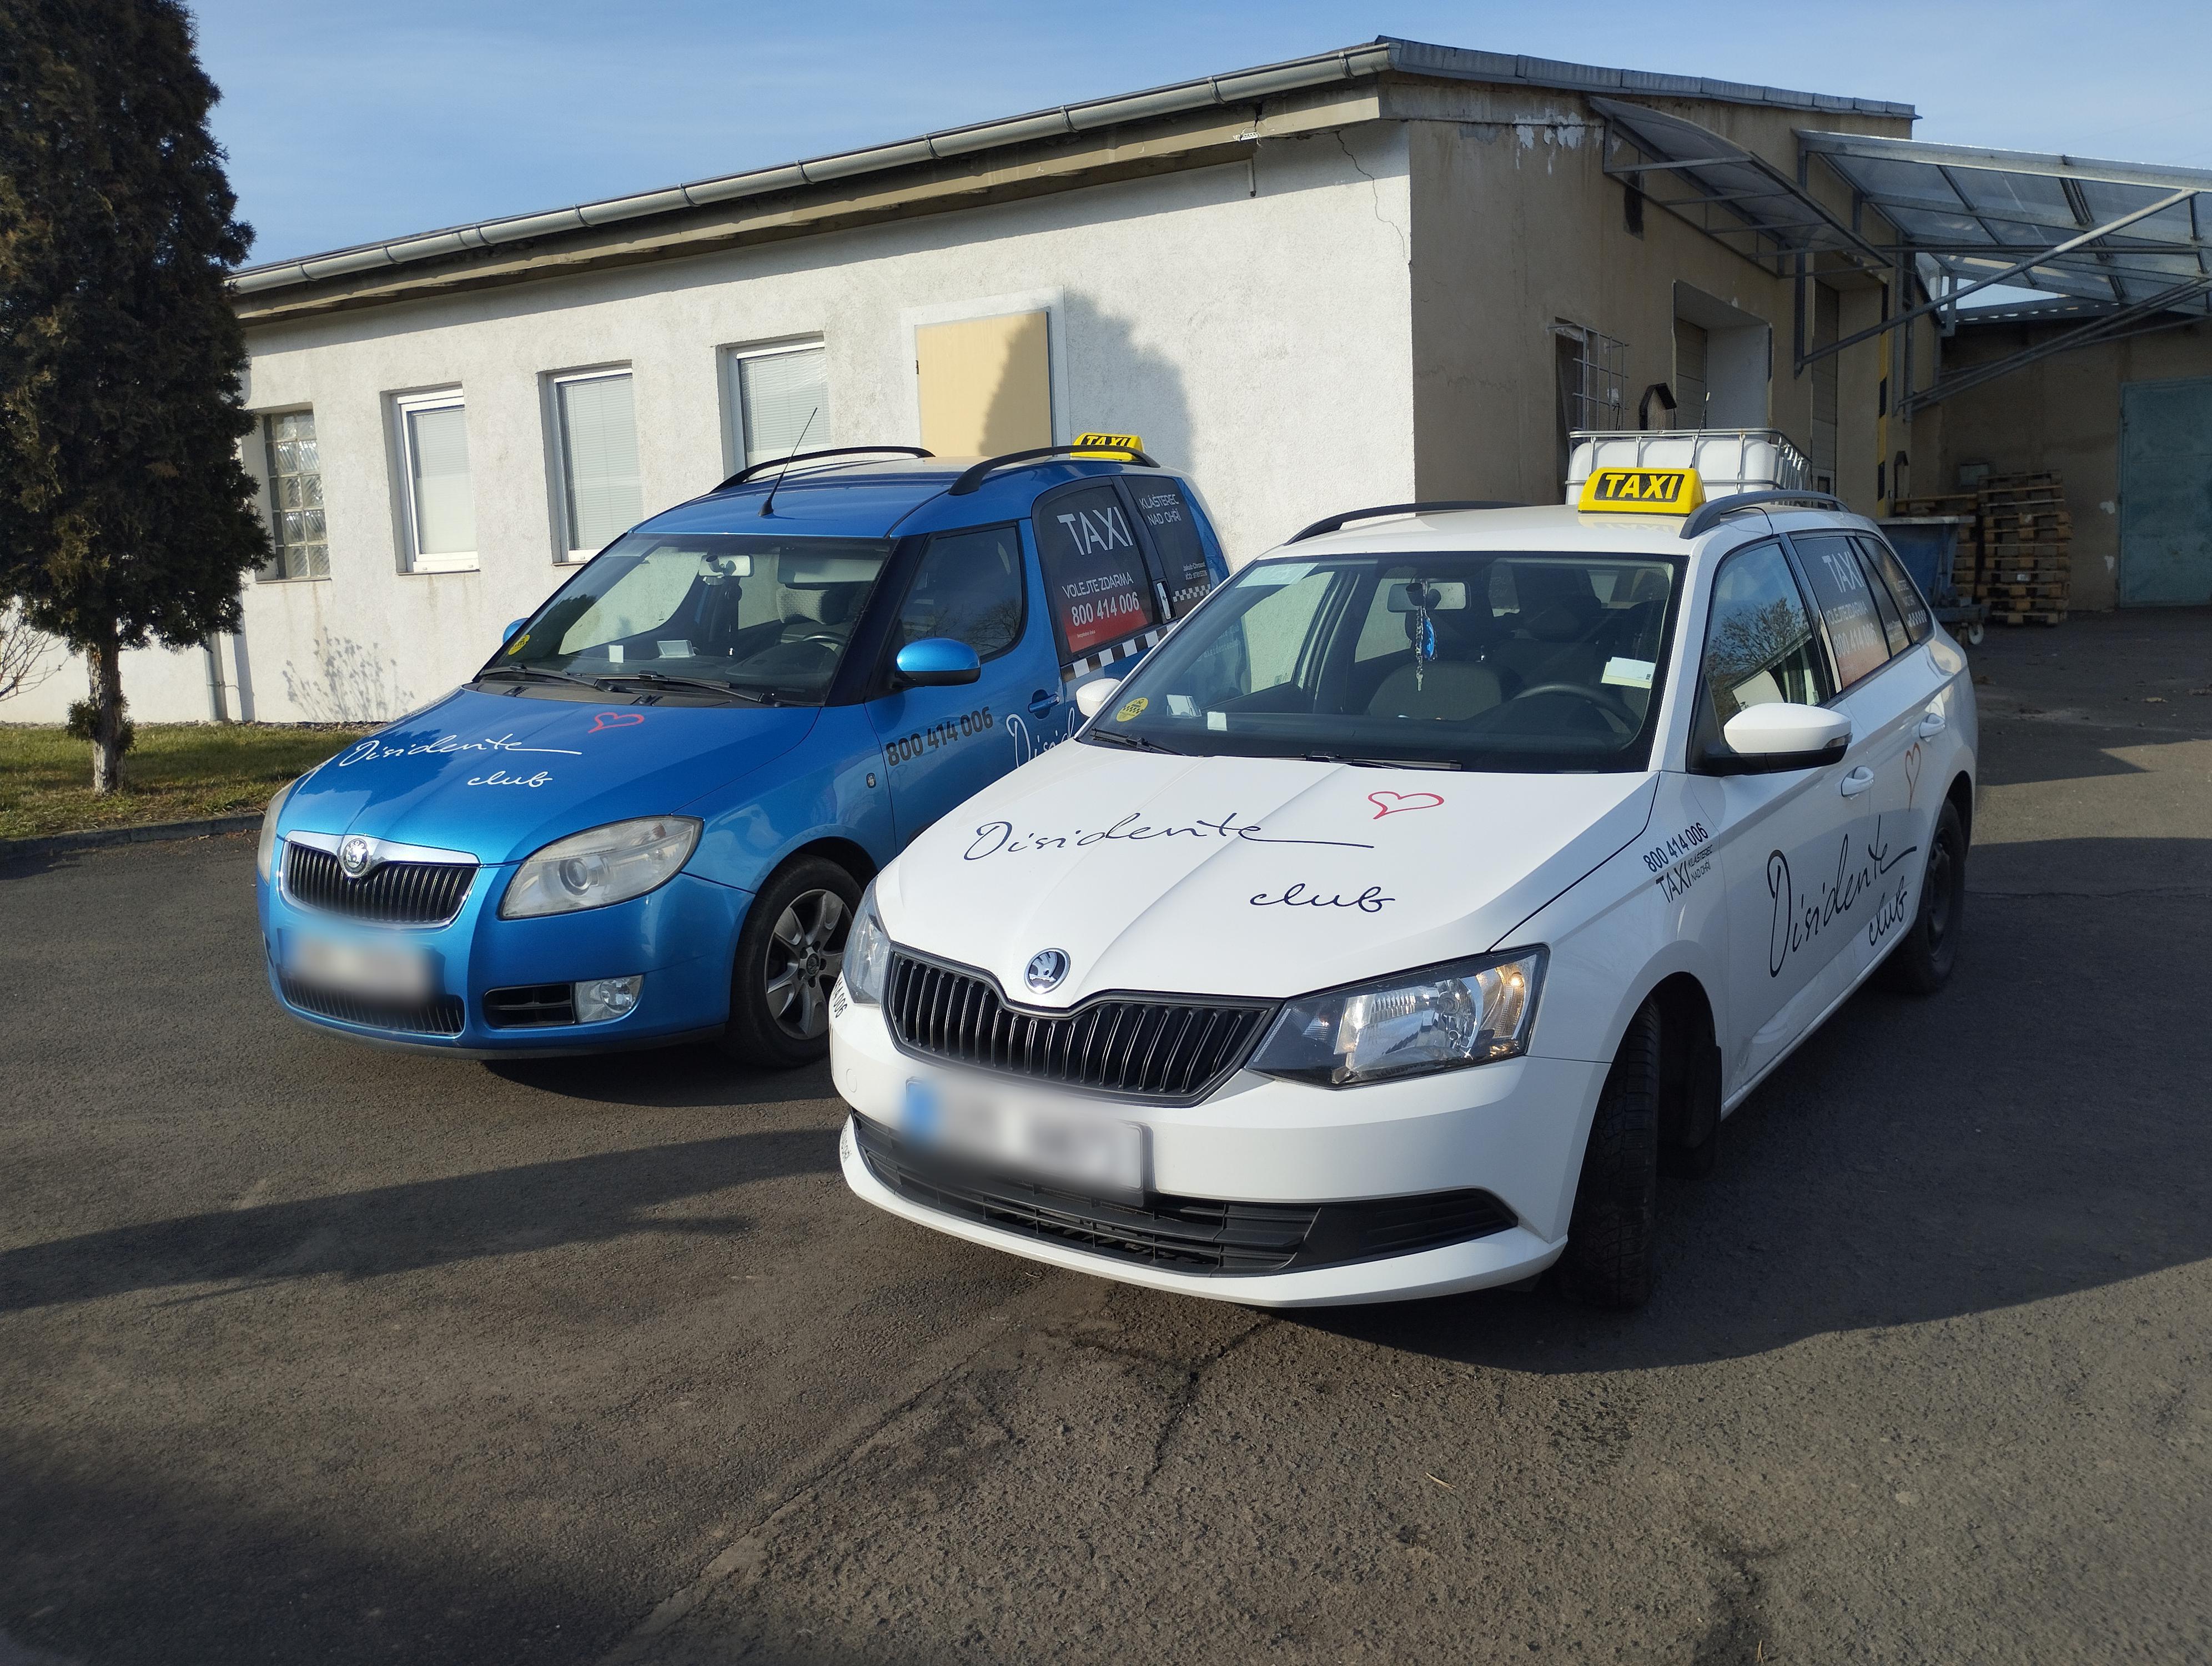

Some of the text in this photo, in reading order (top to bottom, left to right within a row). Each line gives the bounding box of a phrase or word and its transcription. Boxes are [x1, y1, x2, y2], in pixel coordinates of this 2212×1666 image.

[1087, 435, 1128, 446] TAXI
[1605, 474, 1679, 499] TAXI
[1057, 506, 1133, 555] TAXI
[1147, 513, 1164, 526] NAD
[1062, 571, 1134, 599] VOLEJTE ZDARMA
[1822, 551, 1866, 593] TAXI
[1072, 591, 1139, 626] 800 414 006
[339, 734, 582, 767] Disidente
[886, 706, 994, 766] 800 414 006
[467, 771, 553, 787] club
[964, 812, 1374, 861] Disidente
[1643, 822, 1708, 872] 800 414 006
[1249, 883, 1396, 913] club
[1656, 861, 1692, 903] TAXI
[1767, 814, 1917, 977] Disidente
[1869, 876, 1908, 946] club
[833, 992, 848, 1018] 006
